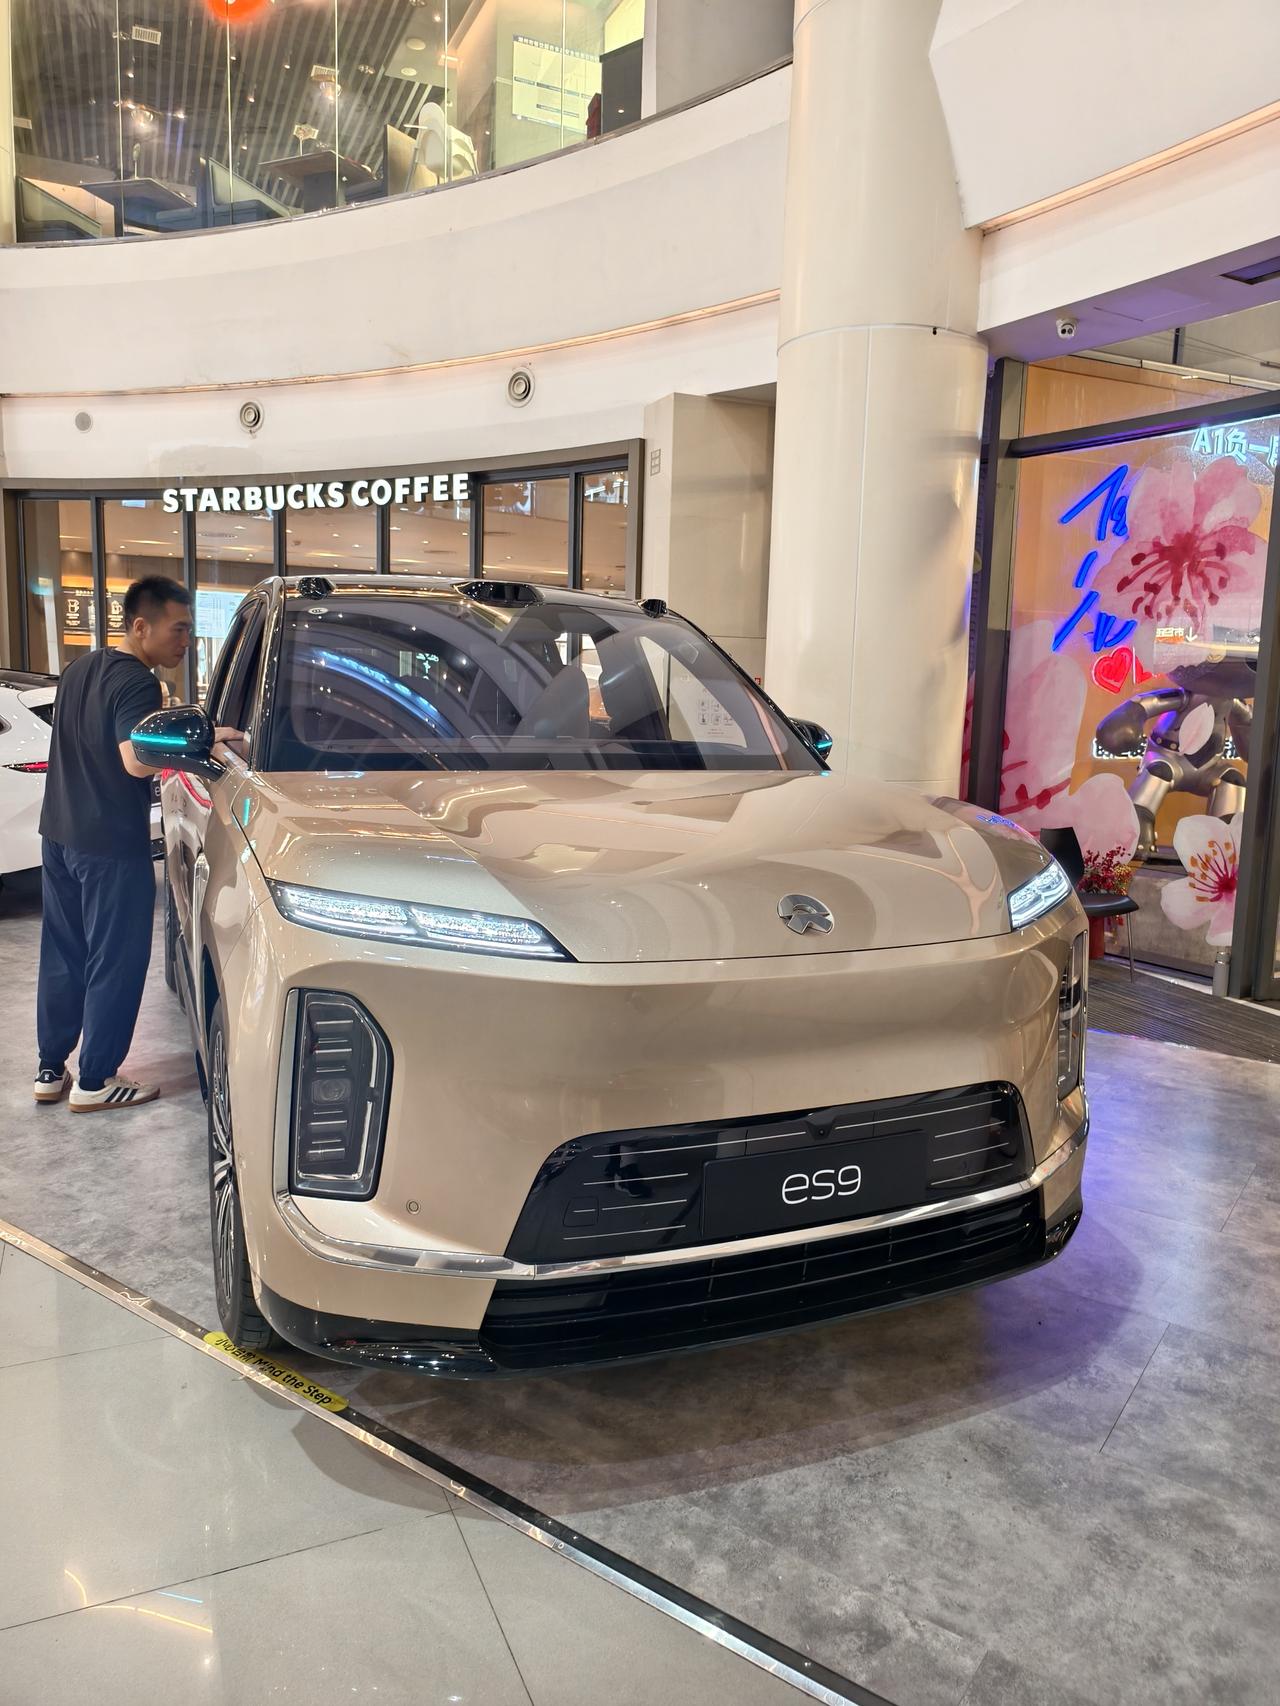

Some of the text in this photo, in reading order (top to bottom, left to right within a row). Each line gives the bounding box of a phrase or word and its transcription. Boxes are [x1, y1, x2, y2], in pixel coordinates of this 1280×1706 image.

[162, 473, 470, 514] STARBUCKS COFFEE
[782, 1164, 862, 1205] es9
[254, 1358, 286, 1378] Mind
[282, 1373, 304, 1389] the
[303, 1384, 333, 1405] Step
